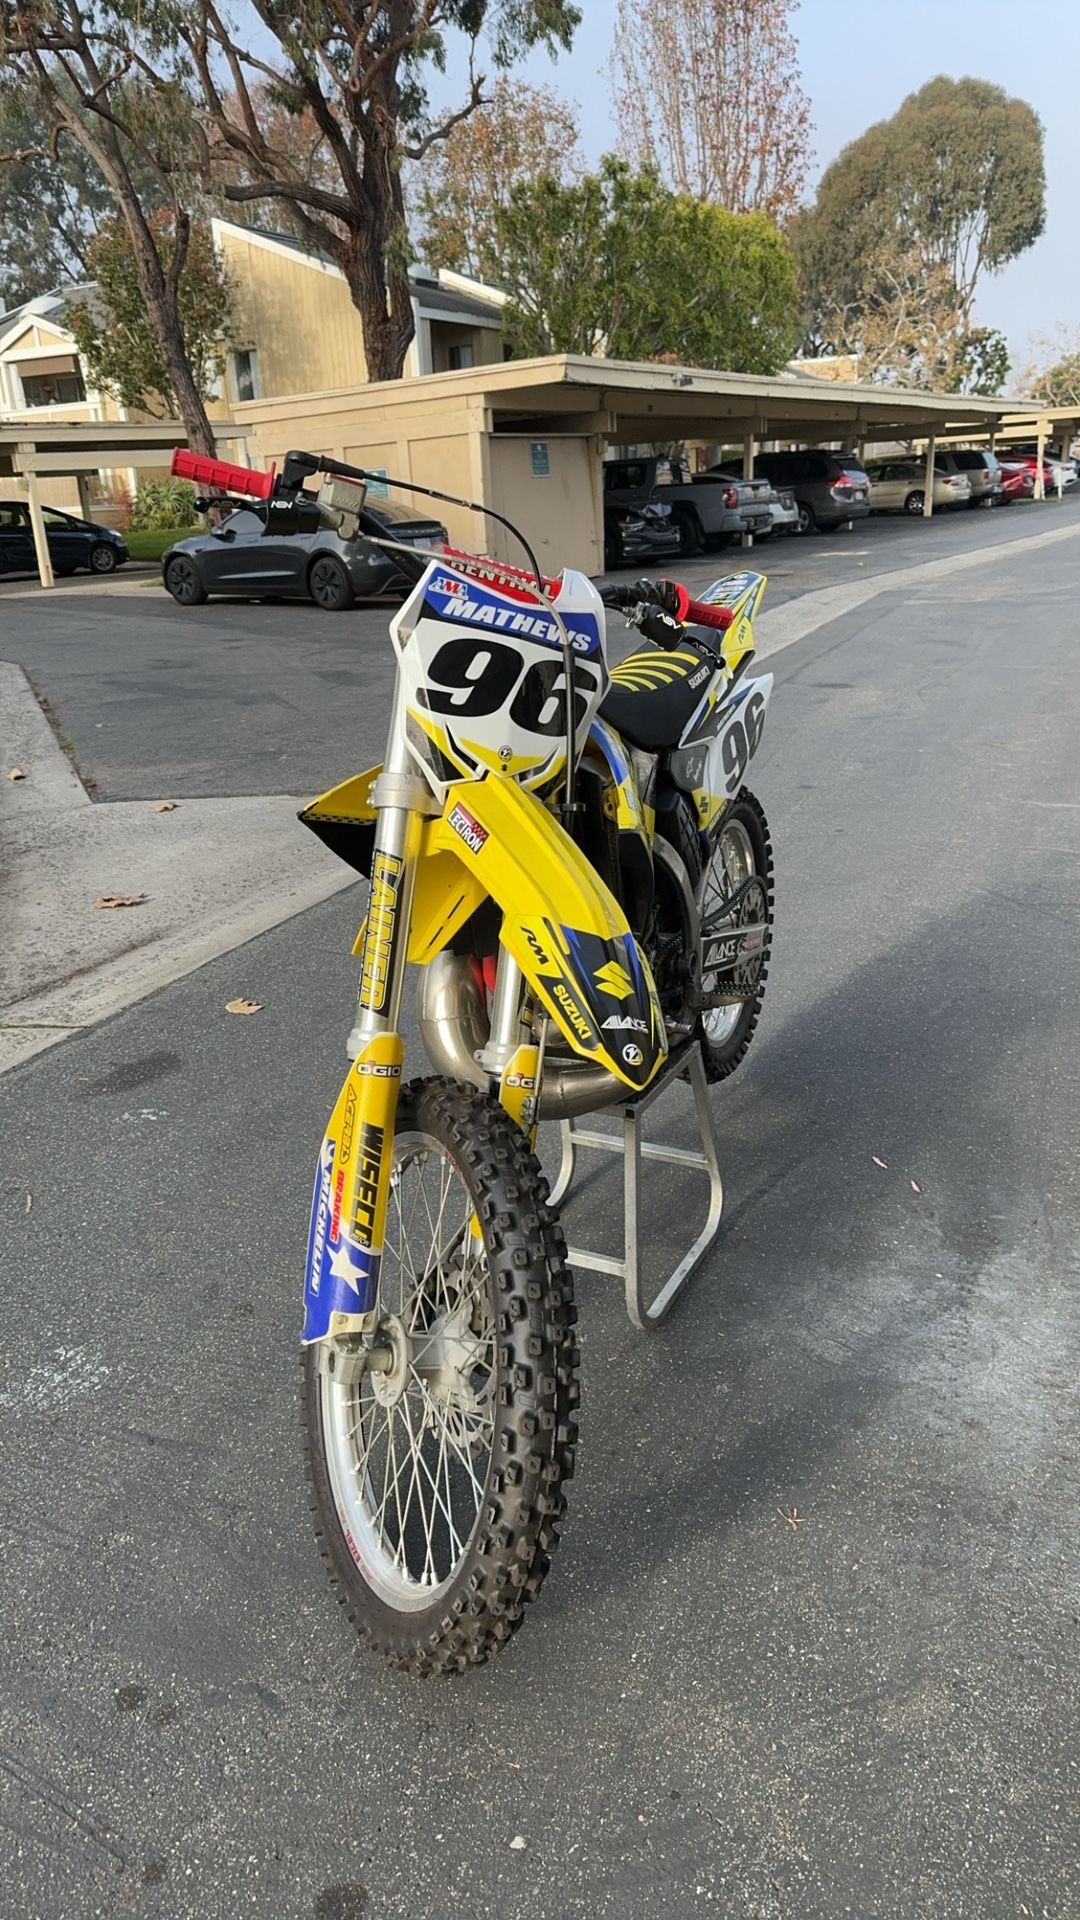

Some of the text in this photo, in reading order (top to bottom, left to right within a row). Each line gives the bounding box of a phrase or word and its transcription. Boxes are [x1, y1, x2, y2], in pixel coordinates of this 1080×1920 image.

[430, 577, 468, 600] AMA
[442, 598, 591, 651] MATHEWS
[416, 638, 598, 737] 96
[722, 692, 765, 794] 96
[552, 984, 592, 1040] SUZUKI
[330, 1170, 346, 1245] BRAKING
[350, 1121, 385, 1248] WISECO
[311, 1168, 332, 1293] MICHELIN
